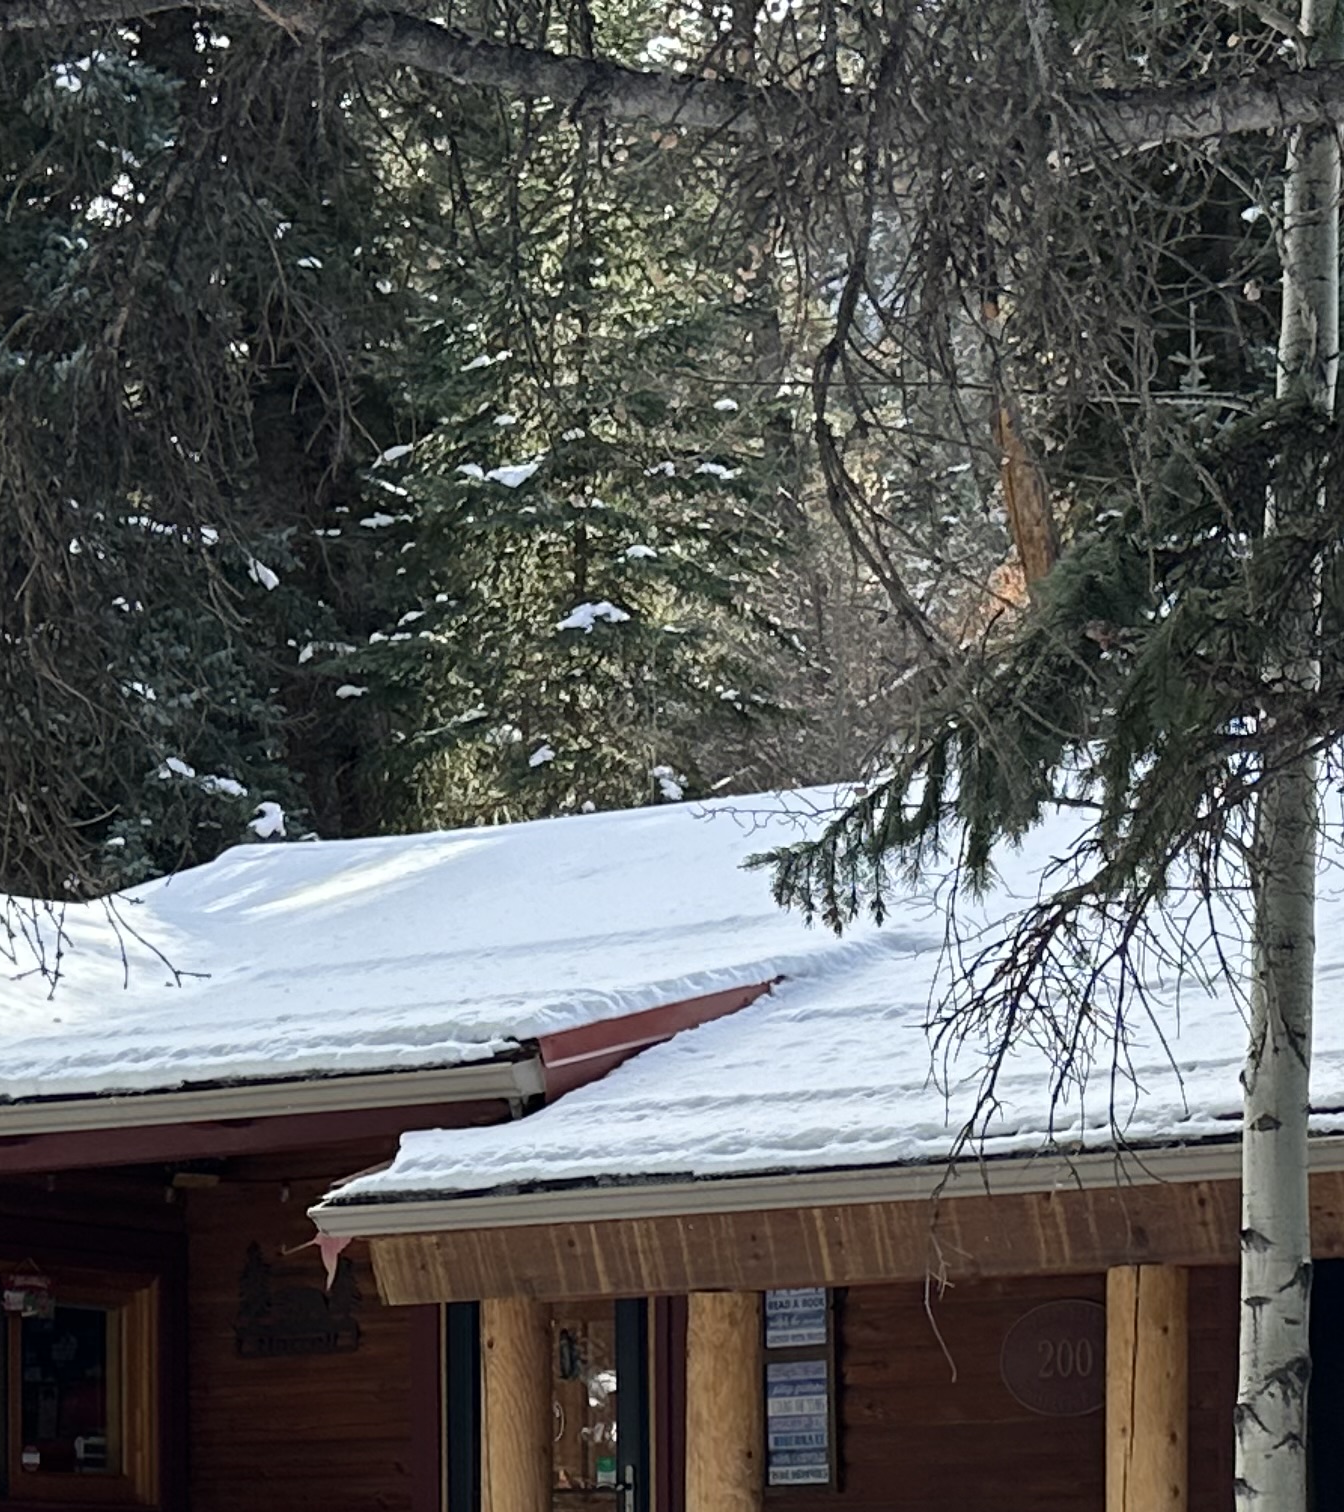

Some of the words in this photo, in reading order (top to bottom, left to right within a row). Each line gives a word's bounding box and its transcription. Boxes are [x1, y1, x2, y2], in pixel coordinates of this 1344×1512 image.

[768, 1300, 791, 1311] READ
[802, 1297, 825, 1307] BOOK
[1038, 1338, 1093, 1378] 200
